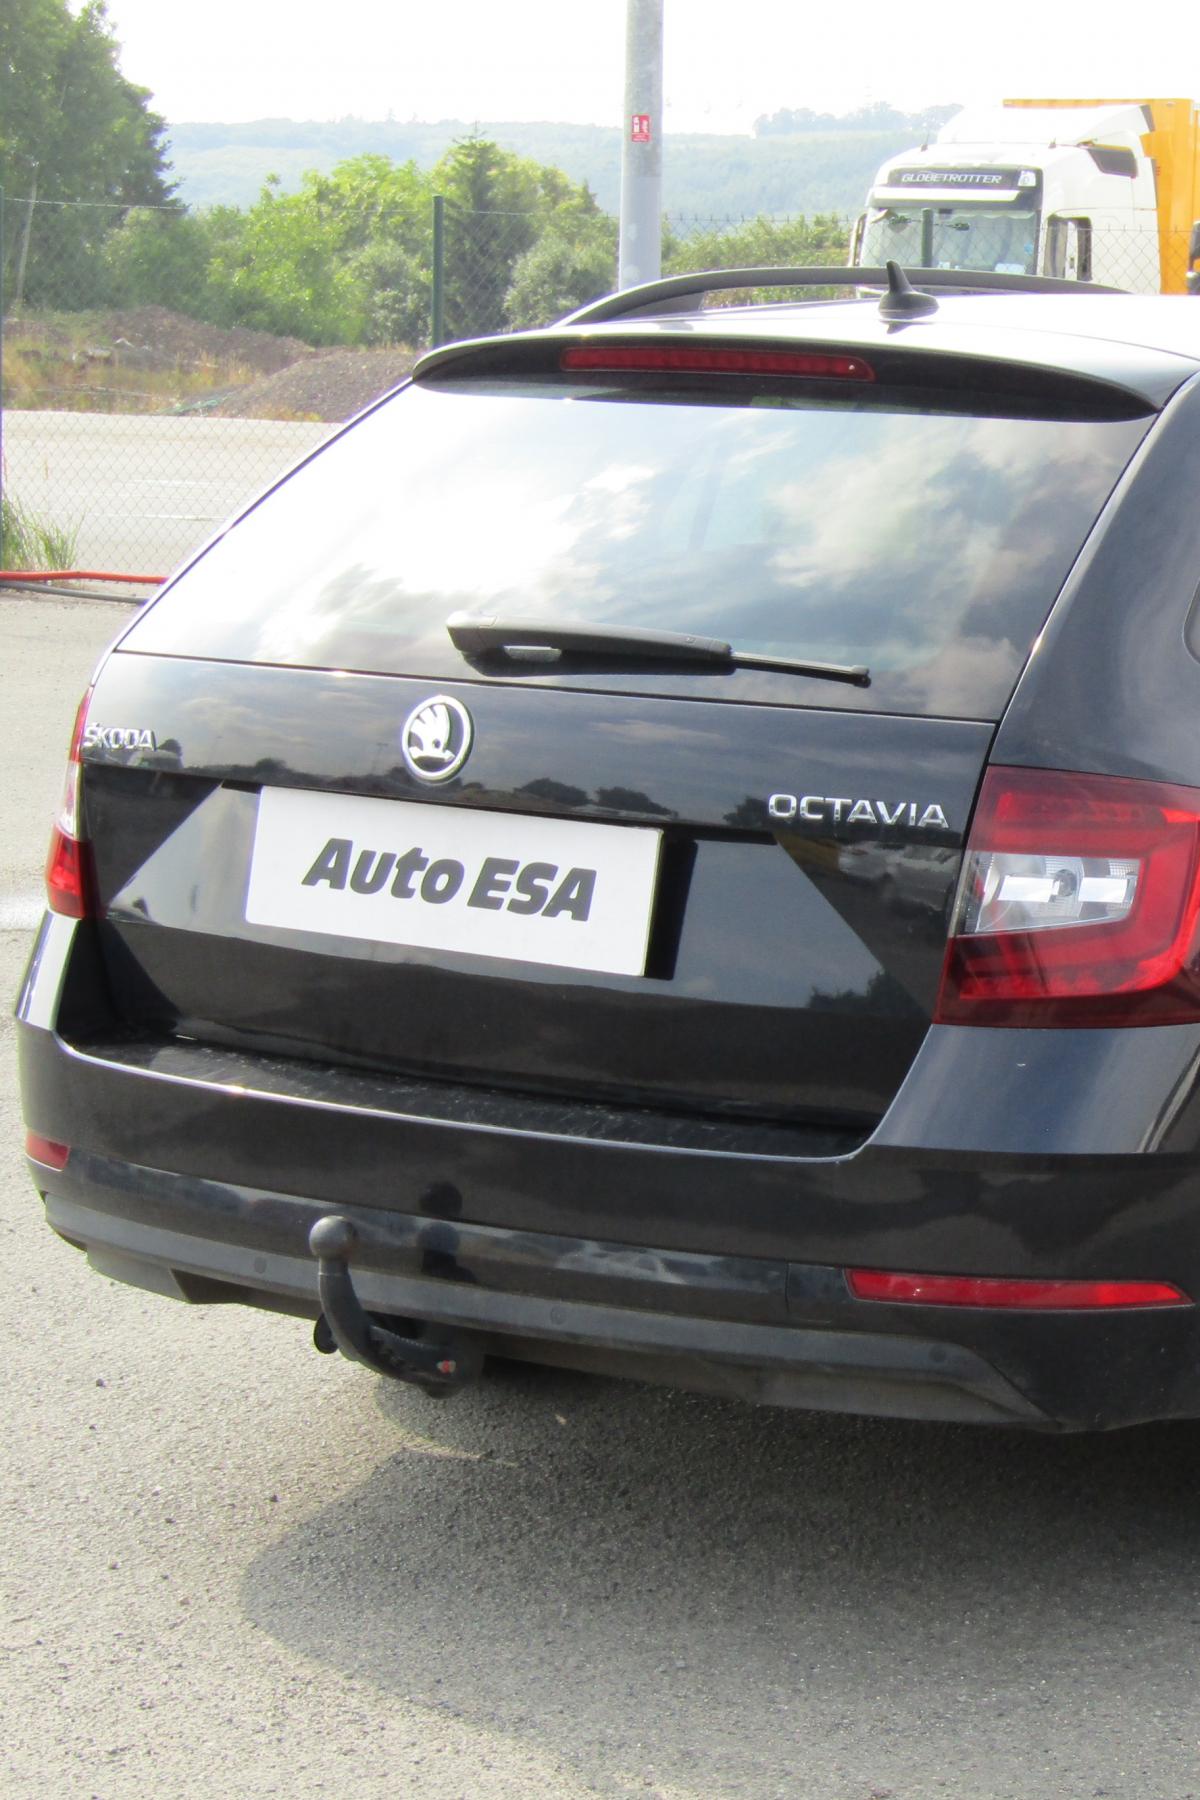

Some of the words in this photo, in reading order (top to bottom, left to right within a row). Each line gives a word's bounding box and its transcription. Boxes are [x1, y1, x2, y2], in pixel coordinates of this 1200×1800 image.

[902, 172, 1002, 184] GLOBETROTTER
[768, 794, 950, 829] OCTAVIA
[301, 838, 465, 904] Auto
[467, 857, 597, 922] ESA
